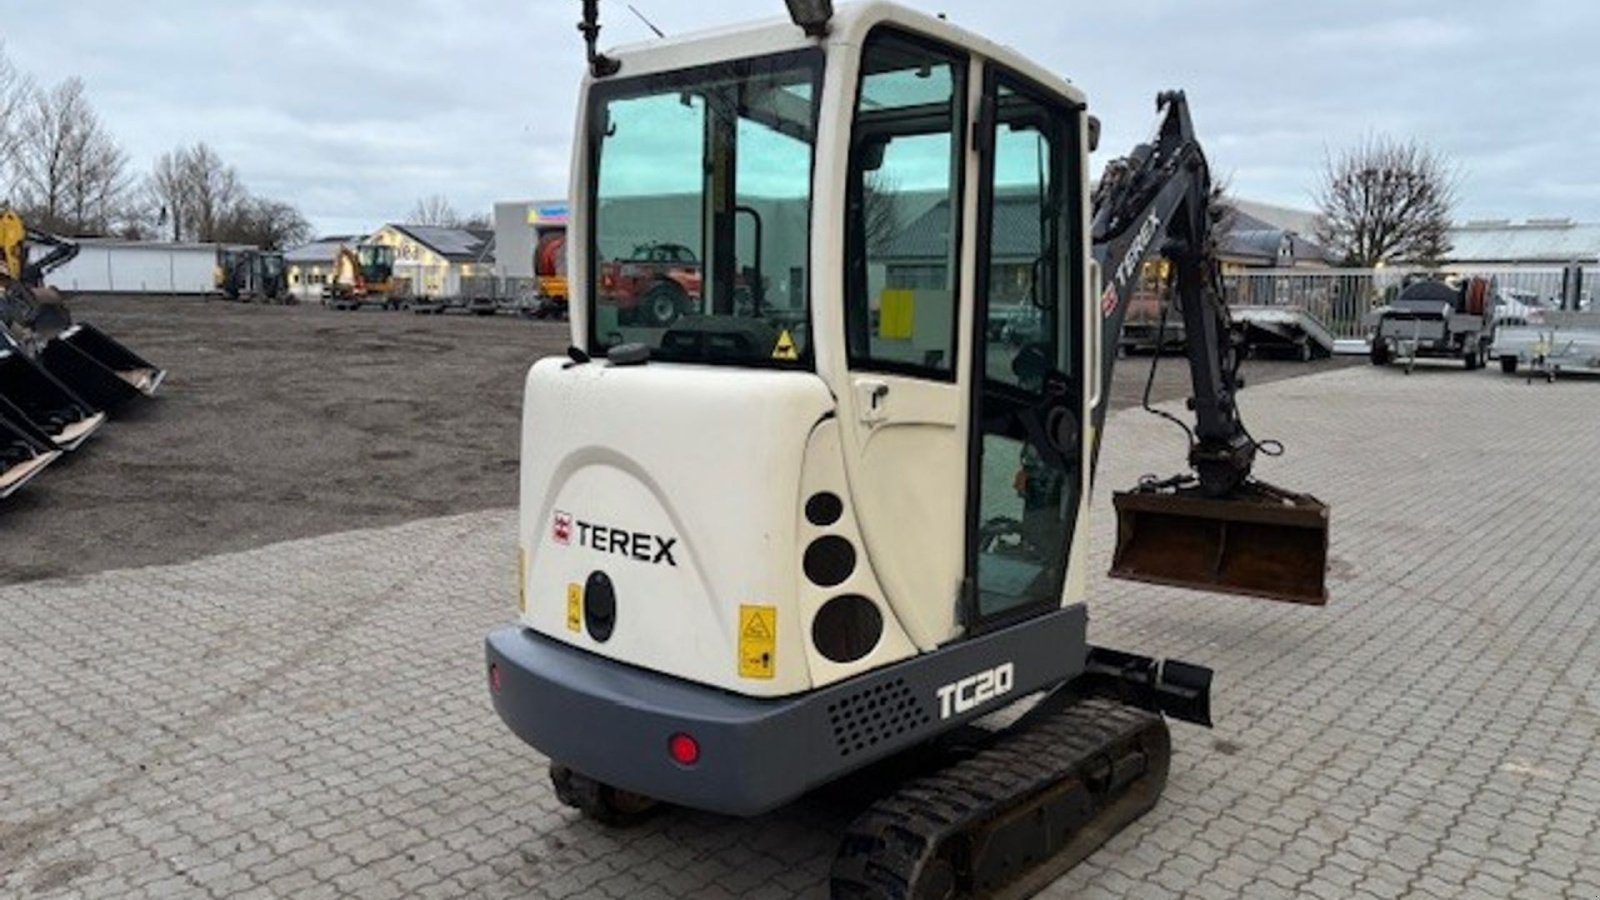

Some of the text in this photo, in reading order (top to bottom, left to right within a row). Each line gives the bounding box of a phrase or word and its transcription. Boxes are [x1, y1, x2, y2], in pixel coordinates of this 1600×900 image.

[1115, 207, 1159, 286] TEREX
[576, 520, 676, 566] TEREX
[937, 662, 1013, 719] TC20
